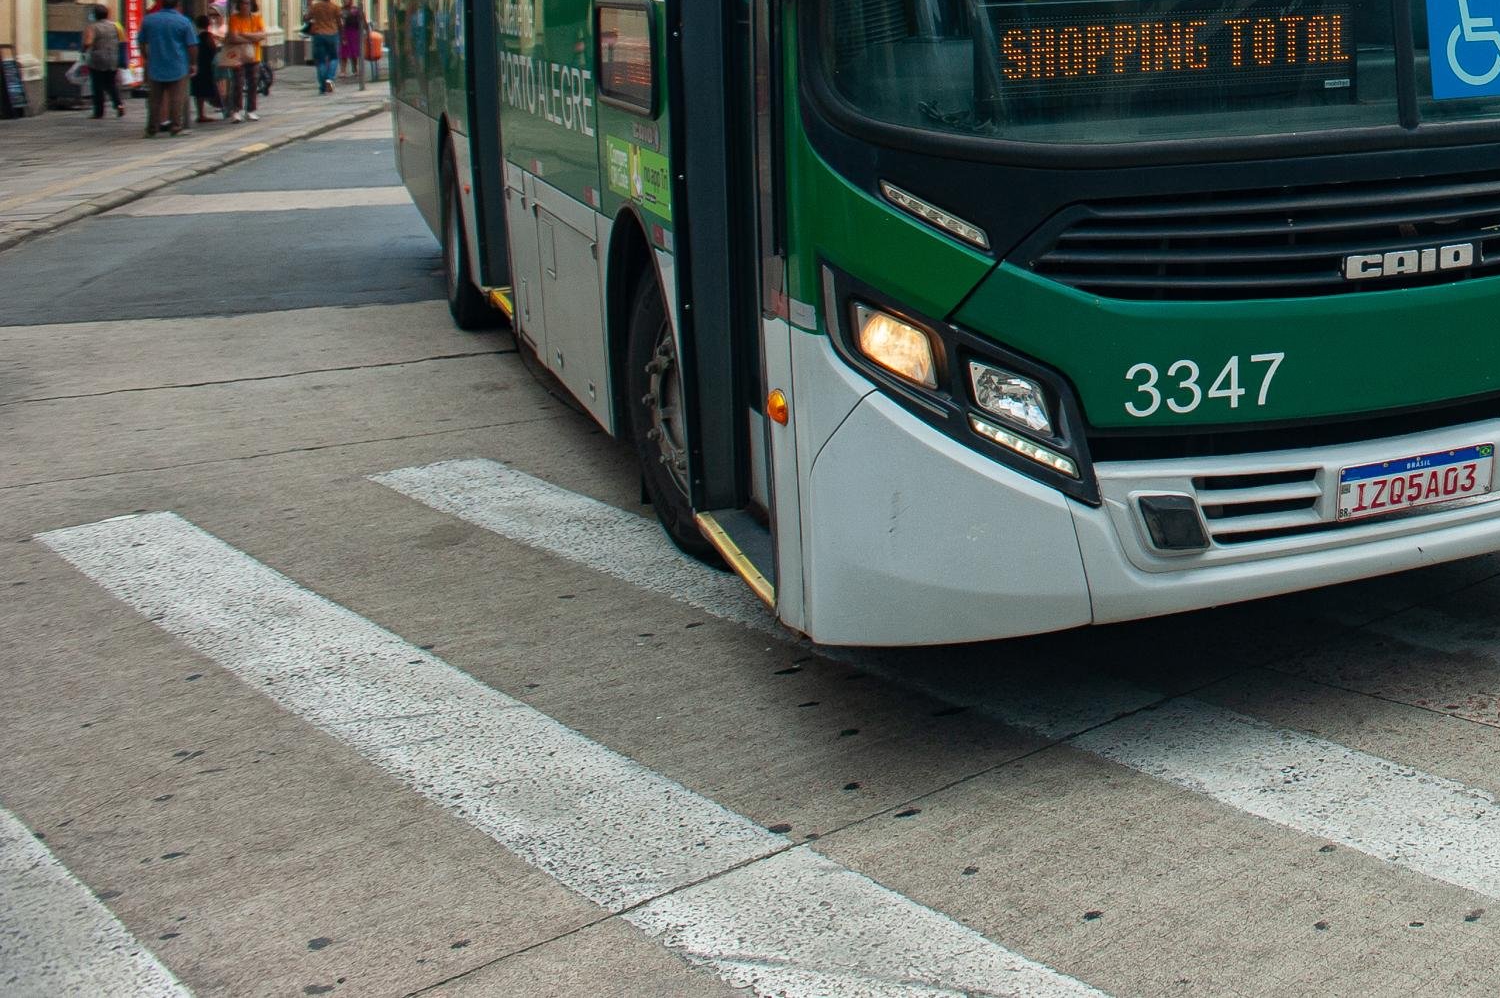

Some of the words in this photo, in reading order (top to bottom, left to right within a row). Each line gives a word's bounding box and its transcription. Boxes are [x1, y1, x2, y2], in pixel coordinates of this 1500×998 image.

[1002, 21, 1208, 80] SHOPPING
[1225, 15, 1350, 67] TOTAL
[499, 51, 536, 115] PORTO
[538, 59, 595, 138] ALEGRE
[1346, 242, 1473, 280] CAIO
[1124, 352, 1286, 418] 3347
[1352, 463, 1478, 513] IZQ5A03
[1406, 459, 1431, 470] BRASIL
